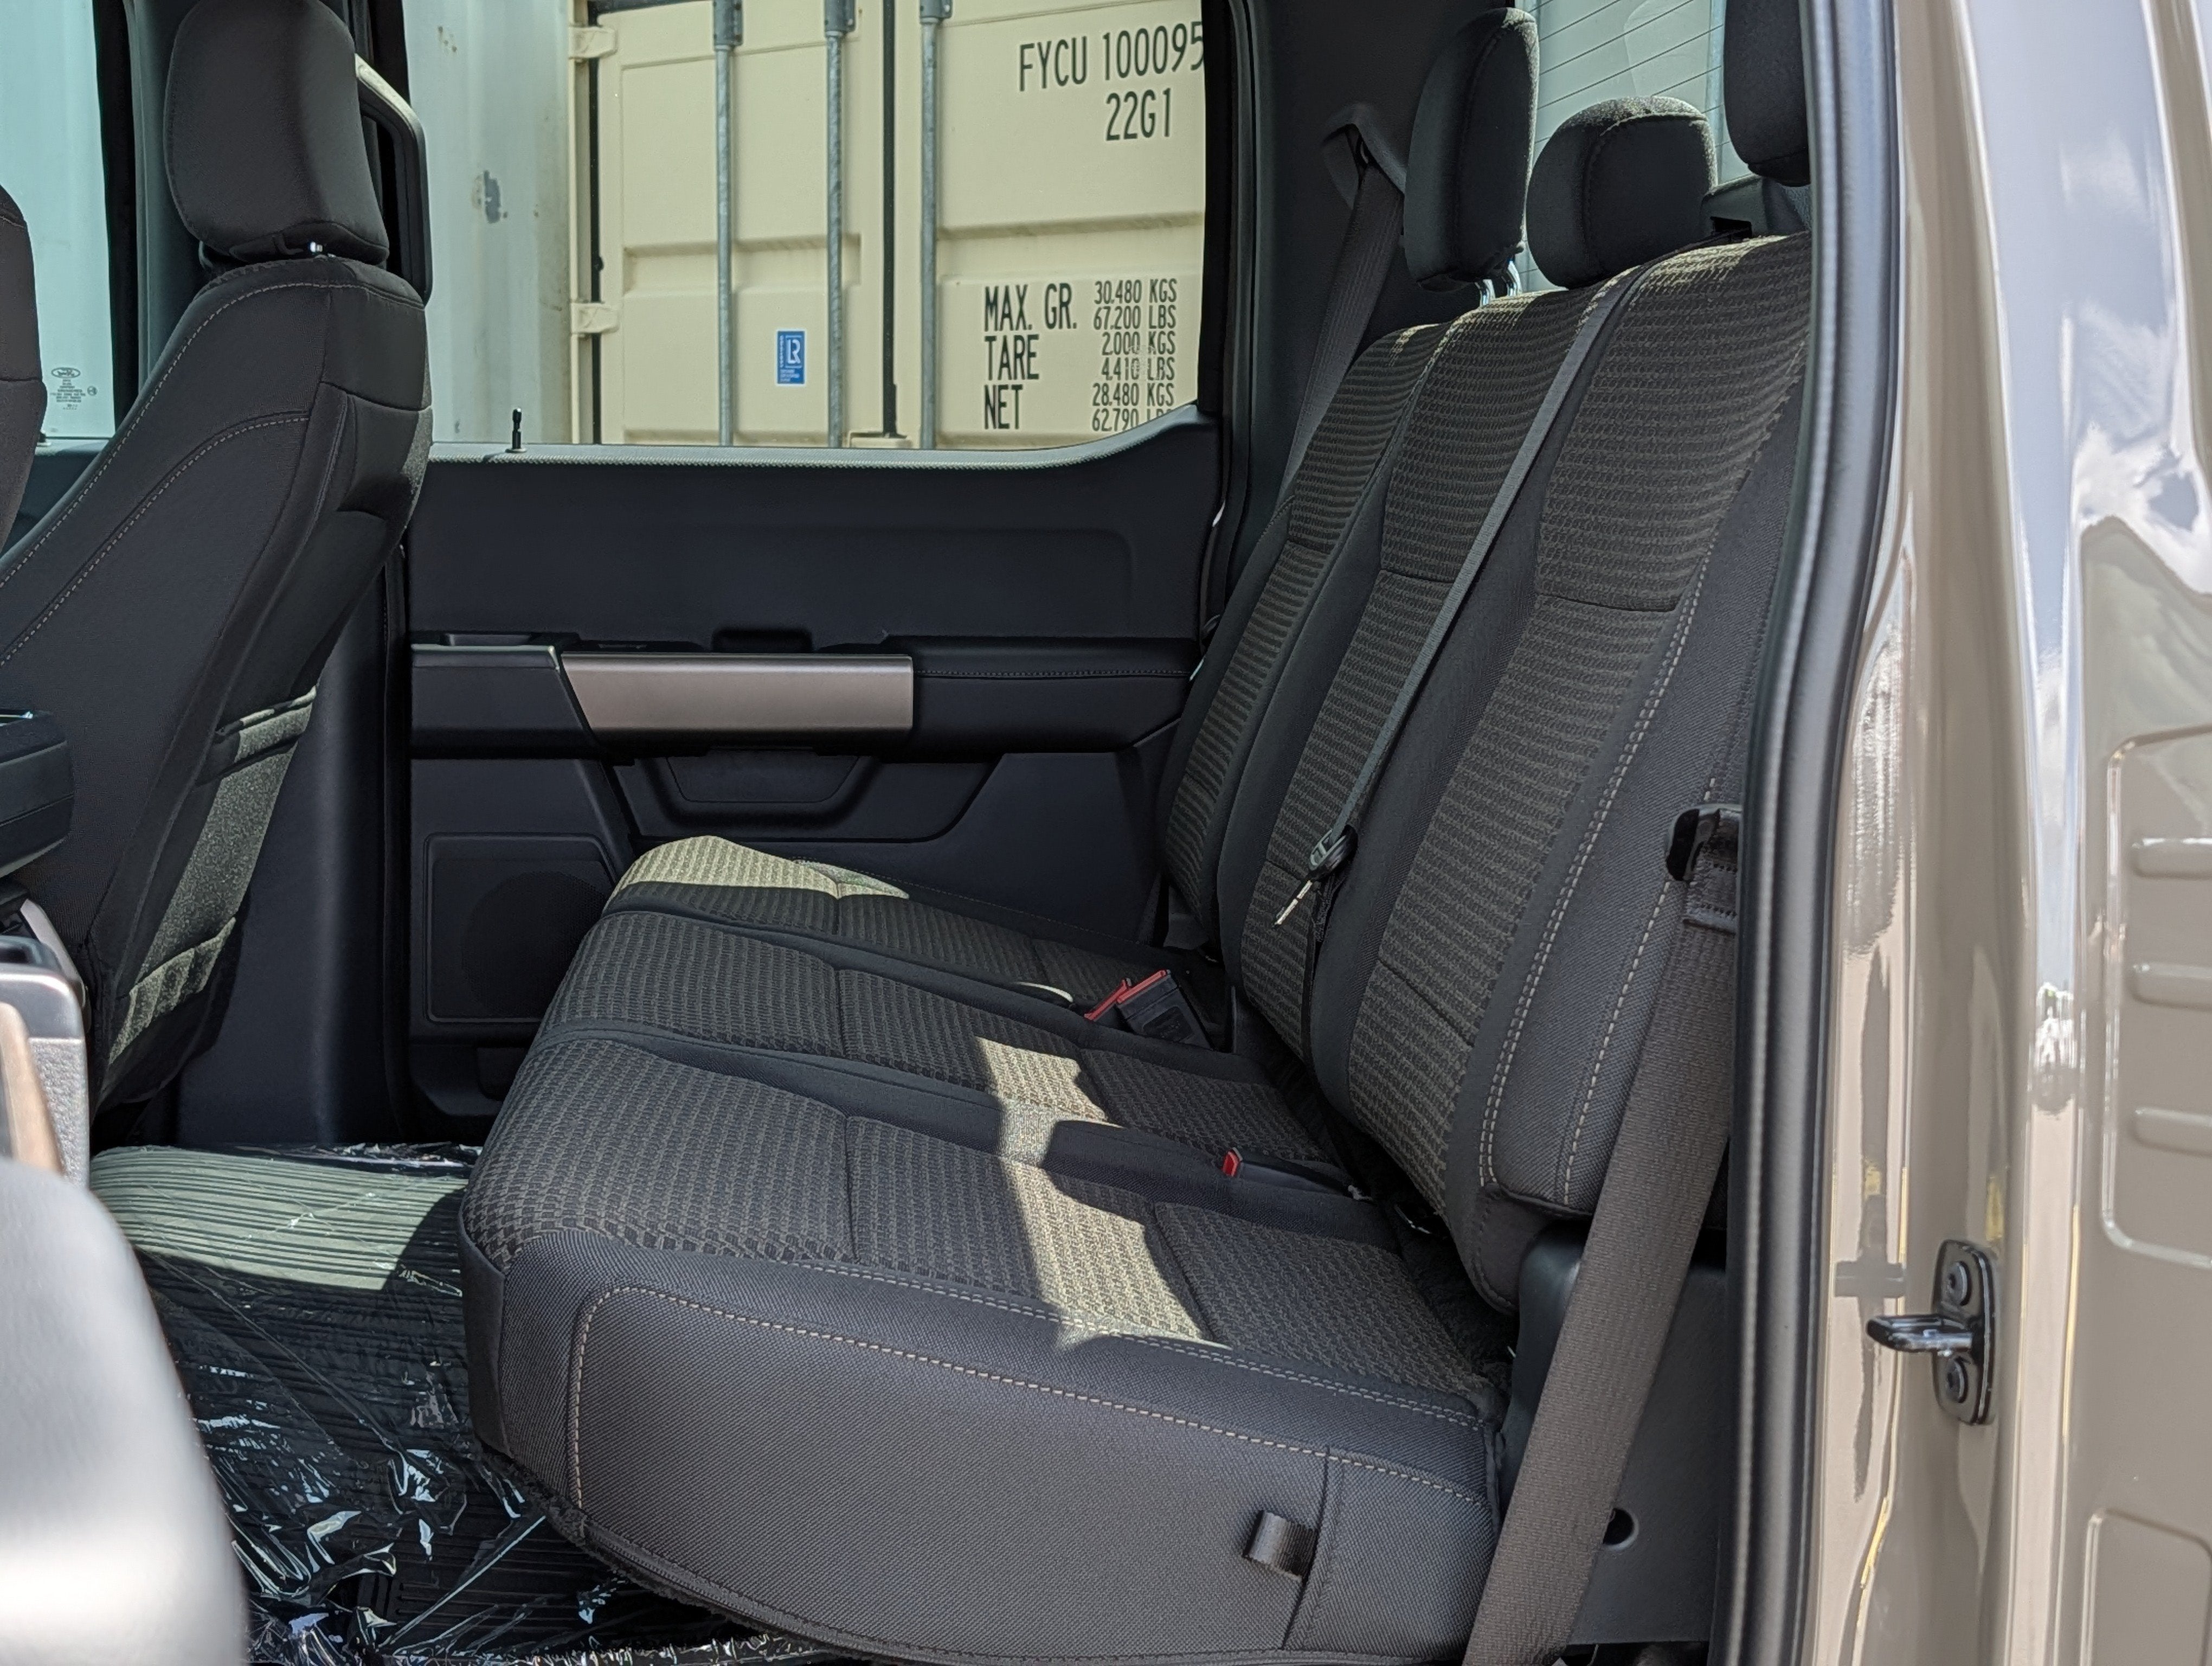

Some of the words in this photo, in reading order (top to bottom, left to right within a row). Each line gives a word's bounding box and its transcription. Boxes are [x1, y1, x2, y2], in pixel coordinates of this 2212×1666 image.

[1019, 36, 1087, 92] FYCU
[1103, 21, 1204, 81] 100095
[1106, 88, 1171, 141] 22G1
[1094, 279, 1142, 304] 30.480
[1149, 278, 1177, 303] KGS
[985, 284, 1032, 331] MAX.
[1044, 283, 1077, 330] GR.
[1094, 305, 1141, 330] 67.200
[1148, 305, 1176, 329] LBS
[1102, 331, 1141, 355] 2.000
[1148, 331, 1176, 355] KGS
[985, 334, 1039, 380] TARE
[1101, 357, 1140, 380] 4.410
[1147, 357, 1175, 380] LBS
[984, 384, 1023, 430] NET
[1092, 383, 1139, 406] 28.480
[1147, 383, 1174, 406] KGS
[1092, 408, 1139, 432] 62.790
